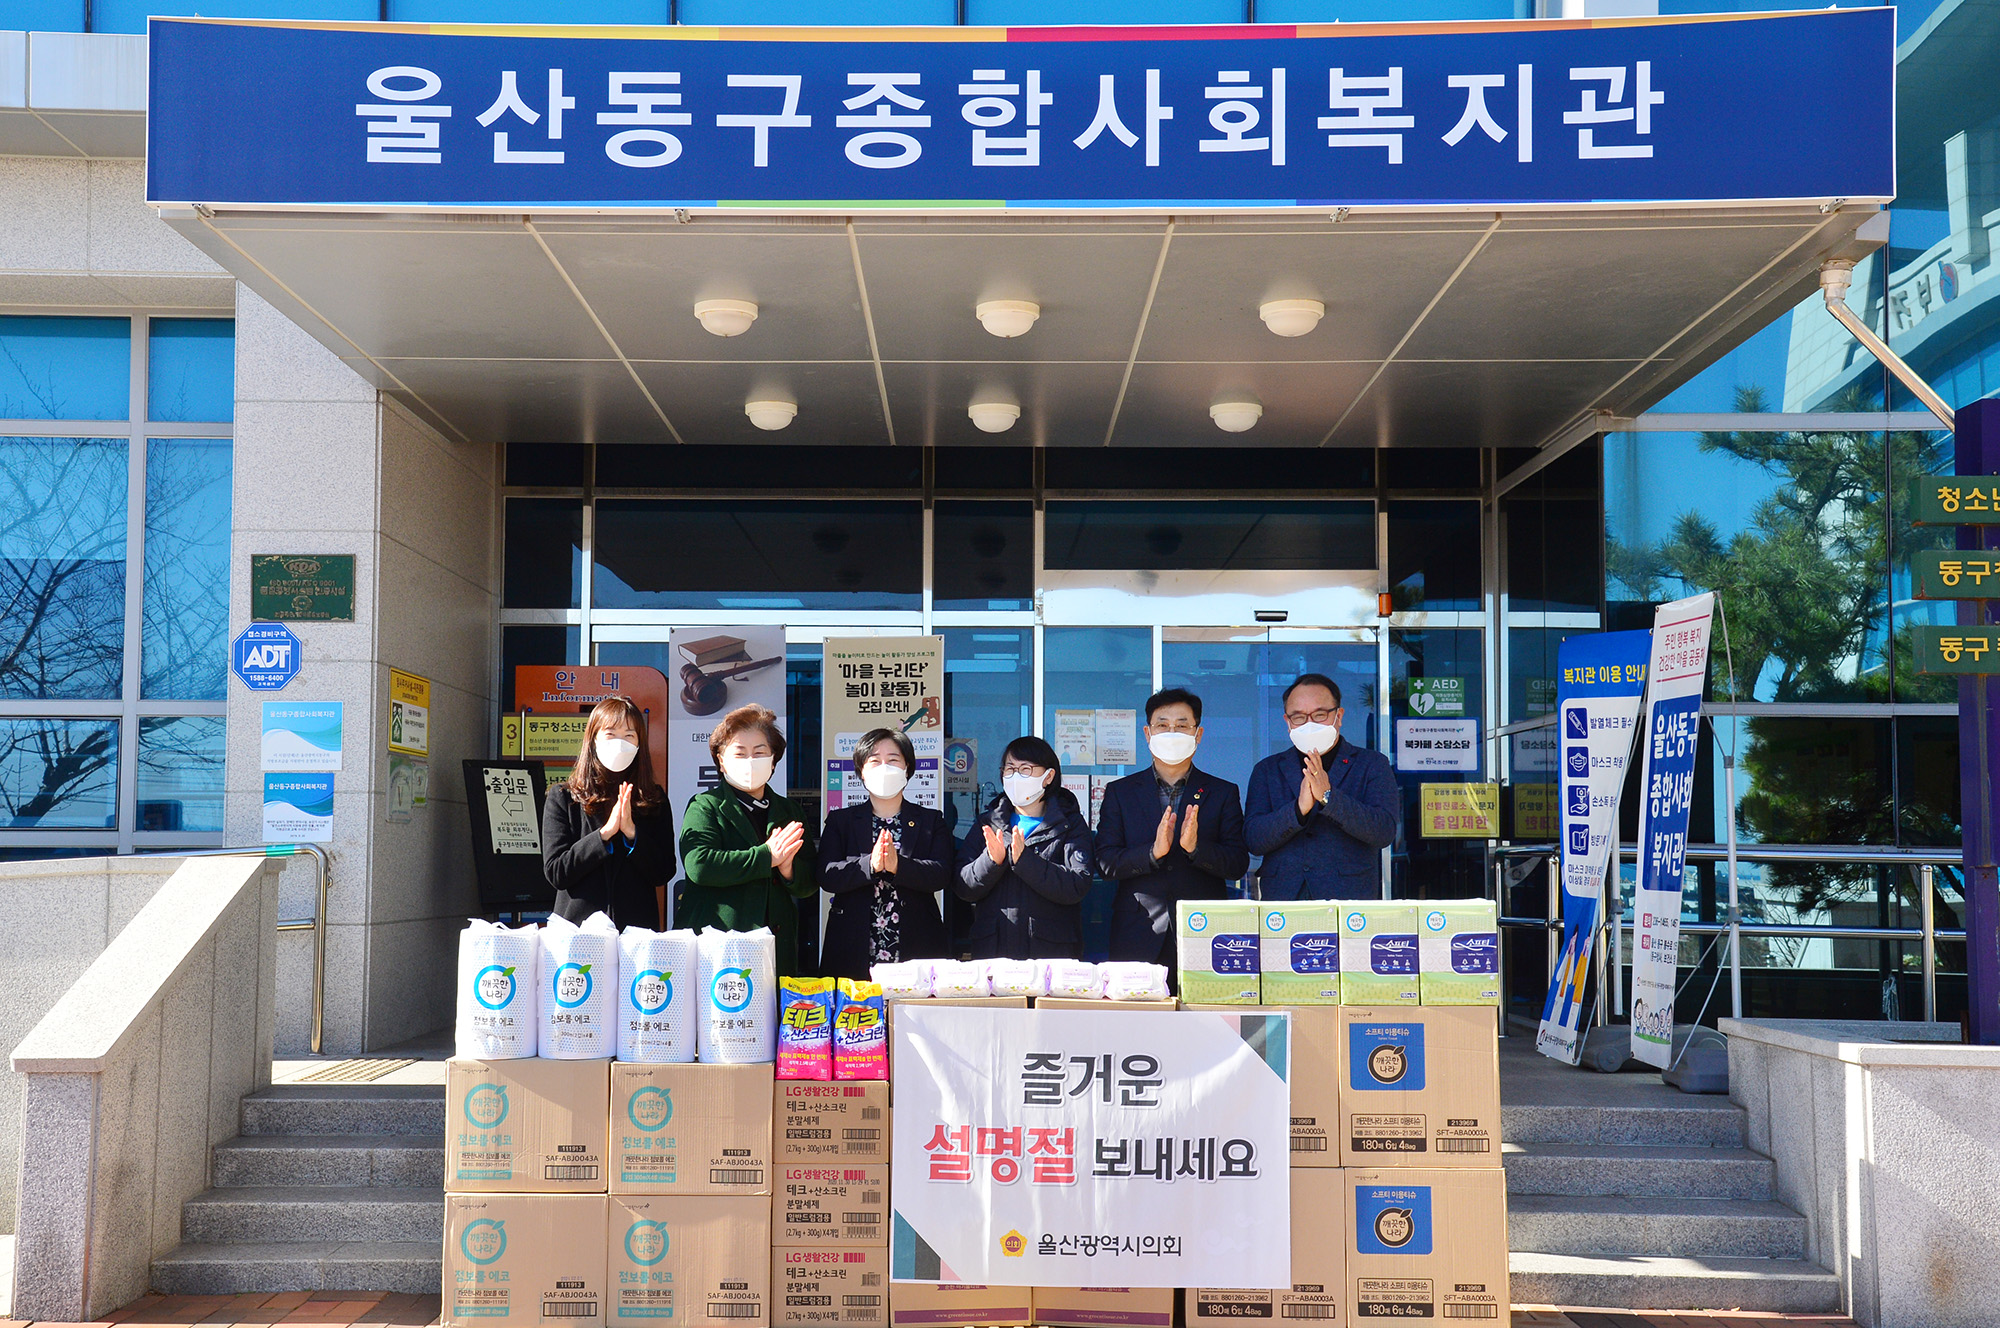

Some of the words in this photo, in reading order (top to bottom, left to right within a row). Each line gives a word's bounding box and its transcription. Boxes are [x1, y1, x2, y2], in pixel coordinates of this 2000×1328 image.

[355, 60, 1664, 170] 울산동구종합사회복지관
[1665, 633, 1676, 650] 주민
[1678, 630, 1688, 648] 행복
[1690, 627, 1701, 645] 복지
[1940, 637, 1989, 662] 동구
[243, 644, 291, 669] ADT
[1659, 653, 1675, 671] 건강한
[1677, 651, 1687, 667] 마을
[1689, 646, 1705, 666] 공동체
[1564, 667, 1596, 684] 복지관
[1600, 665, 1621, 683] 이용
[1626, 664, 1646, 682] 안내
[845, 682, 875, 697] 놀이
[880, 681, 926, 697] 활동가
[1432, 680, 1458, 688] AED
[858, 701, 882, 713] 모집
[885, 701, 909, 713] 안내
[1590, 717, 1619, 729] 발열체크
[507, 724, 517, 740] 3
[1654, 710, 1699, 759] 울산동구
[1405, 740, 1432, 749] 북카페
[1435, 740, 1470, 749] 소담소담
[1592, 757, 1611, 768] 마스크
[491, 776, 527, 795] 출입문
[1650, 772, 1694, 818] 종합사회
[1426, 802, 1467, 810] 선별진료소
[1433, 815, 1488, 829] 출입제한
[1652, 832, 1684, 877] 복지관
[1568, 864, 1584, 875] 마스크
[1227, 939, 1250, 947] 소프티
[482, 979, 508, 990] 깨끗한
[718, 981, 746, 992] 깨끗한
[486, 990, 503, 999] 나라
[561, 988, 581, 997] 나라
[643, 993, 660, 1003] 나라
[723, 993, 741, 1001] 나라
[499, 1017, 514, 1027] 에코
[575, 1014, 590, 1025] 에코
[783, 1005, 827, 1029] 테크
[835, 1008, 880, 1031] 테크
[653, 1022, 670, 1032] 에코
[737, 1019, 754, 1029] 에코
[1365, 1028, 1383, 1036] 소프티
[1385, 1028, 1409, 1036] 미용티슈
[1376, 1056, 1399, 1065] 깨끗한
[1021, 1051, 1163, 1106] 즐거운
[786, 1086, 801, 1096] LG
[803, 1086, 840, 1096] 생활건강
[473, 1097, 500, 1108] 깨끗한
[637, 1100, 664, 1110] 깨끗한
[787, 1101, 807, 1112] 테크
[477, 1109, 496, 1117] 나라
[641, 1112, 660, 1120] 나라
[787, 1116, 819, 1125] 분말세제
[1356, 1117, 1382, 1126] 깨끗한나라
[1384, 1117, 1399, 1125] 소프티
[1401, 1117, 1420, 1125] 미용티슈
[788, 1129, 830, 1138] 일반드럼겸용
[458, 1134, 488, 1147] 점보롤
[491, 1134, 512, 1146] 에코
[622, 1137, 653, 1149] 점보롤
[655, 1137, 676, 1149] 에코
[1362, 1140, 1383, 1150] 180매
[1385, 1140, 1397, 1150] 6입
[1399, 1140, 1416, 1150] 4Bag
[786, 1145, 801, 1154] (2.7kg
[807, 1145, 821, 1154] 300g)
[923, 1124, 1075, 1184] 설명절
[1092, 1137, 1257, 1181] 보내세요
[786, 1169, 801, 1180] LG
[803, 1169, 840, 1180] 생활건강
[787, 1184, 807, 1196] 테크
[1392, 1191, 1416, 1199] 미용티슈
[787, 1199, 819, 1209] 분말세제
[788, 1213, 830, 1222] 일반드럼겸용
[1382, 1219, 1406, 1228] 깨끗한
[470, 1232, 498, 1243] 깨끗한
[634, 1234, 660, 1244] 깨끗한
[786, 1229, 801, 1238] (2.7kg
[807, 1229, 821, 1238] 300g)
[474, 1244, 493, 1254] 나라
[1005, 1240, 1022, 1249] 의회
[1038, 1233, 1182, 1257] 울산광역시의회
[638, 1246, 656, 1255] 나라
[786, 1252, 801, 1263] LG
[803, 1252, 840, 1263] 생활건강
[455, 1270, 486, 1283] 점보롤
[488, 1270, 510, 1282] 에코
[619, 1271, 649, 1284] 점보롤
[652, 1271, 674, 1283] 에코
[787, 1267, 807, 1279] 테크
[787, 1283, 819, 1292] 분말세제
[1363, 1282, 1388, 1290] 깨끗한나라
[1390, 1282, 1406, 1290] 소프티
[1407, 1282, 1427, 1290] 미용티슈
[788, 1296, 830, 1305] 일반드럼겸용
[1207, 1305, 1229, 1315] 180매
[1231, 1305, 1243, 1315] 6입
[1245, 1305, 1262, 1316] 4Bag
[1368, 1305, 1390, 1314] 180매
[1392, 1305, 1403, 1314] 6입
[1406, 1305, 1423, 1316] 4Bag
[786, 1312, 801, 1321] (2.7kg
[807, 1312, 821, 1321] 300g)
